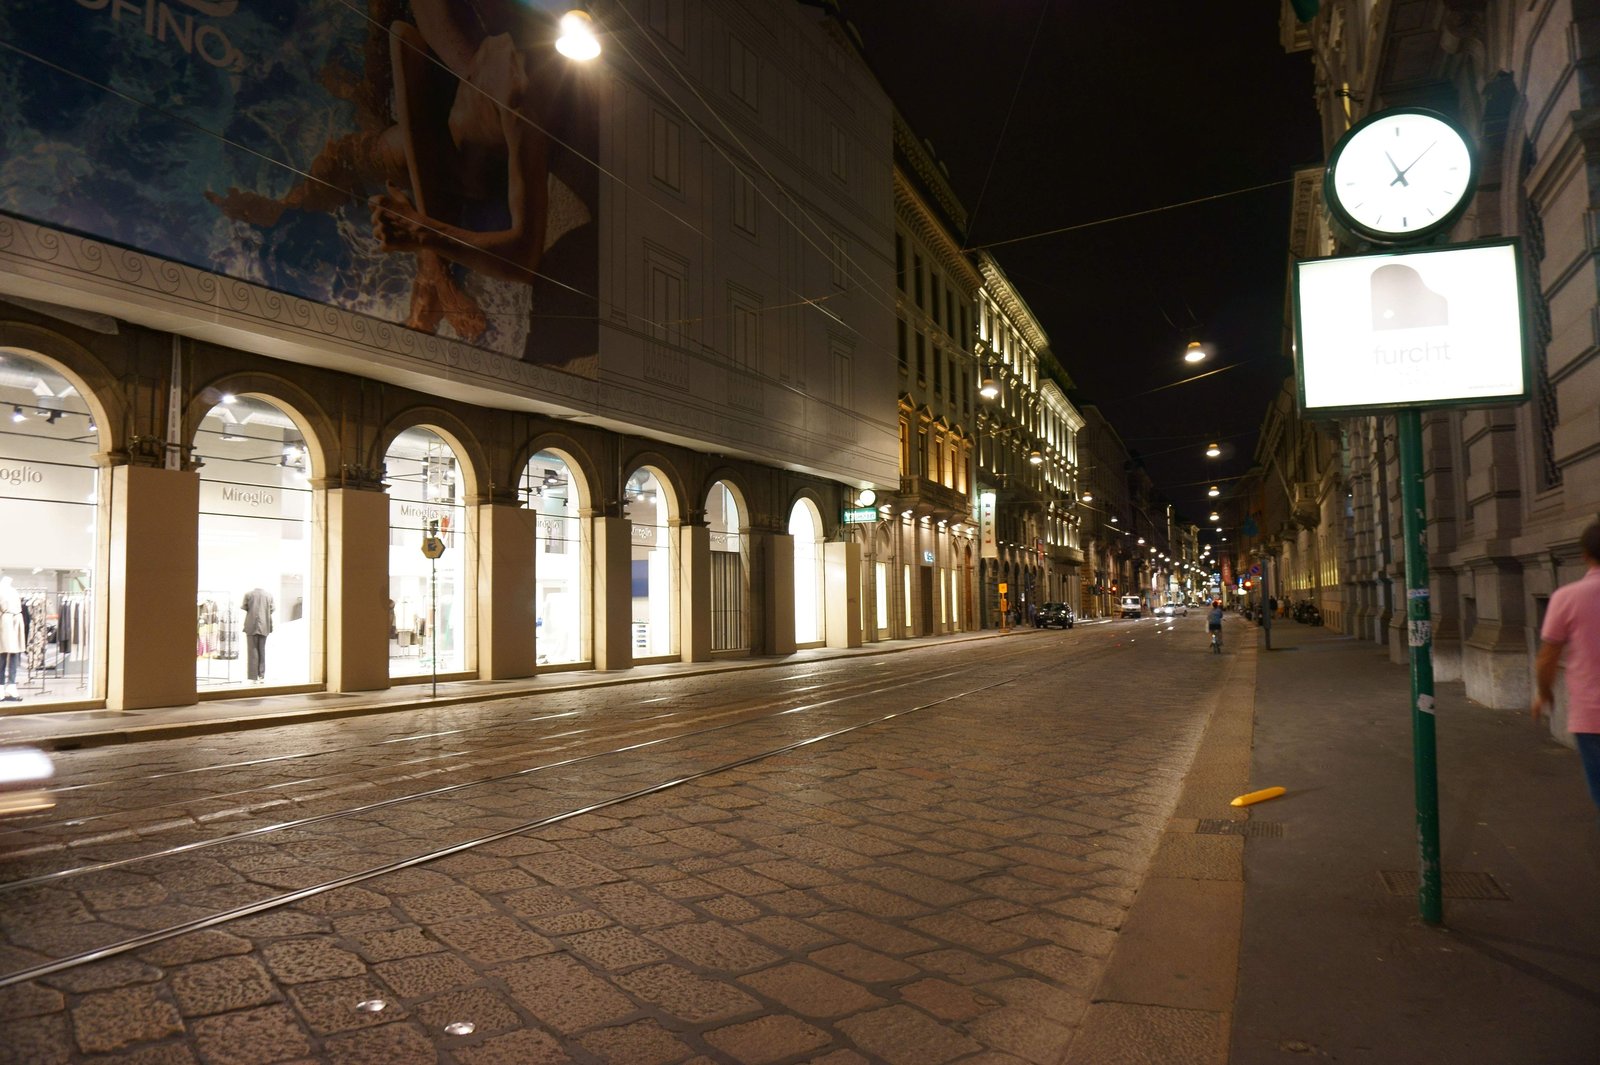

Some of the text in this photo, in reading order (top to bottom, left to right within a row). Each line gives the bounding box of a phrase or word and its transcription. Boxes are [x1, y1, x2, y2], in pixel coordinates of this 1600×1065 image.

[1373, 341, 1452, 365] furcht
[222, 487, 274, 507] Miroglio
[400, 504, 438, 521] Miroglio
